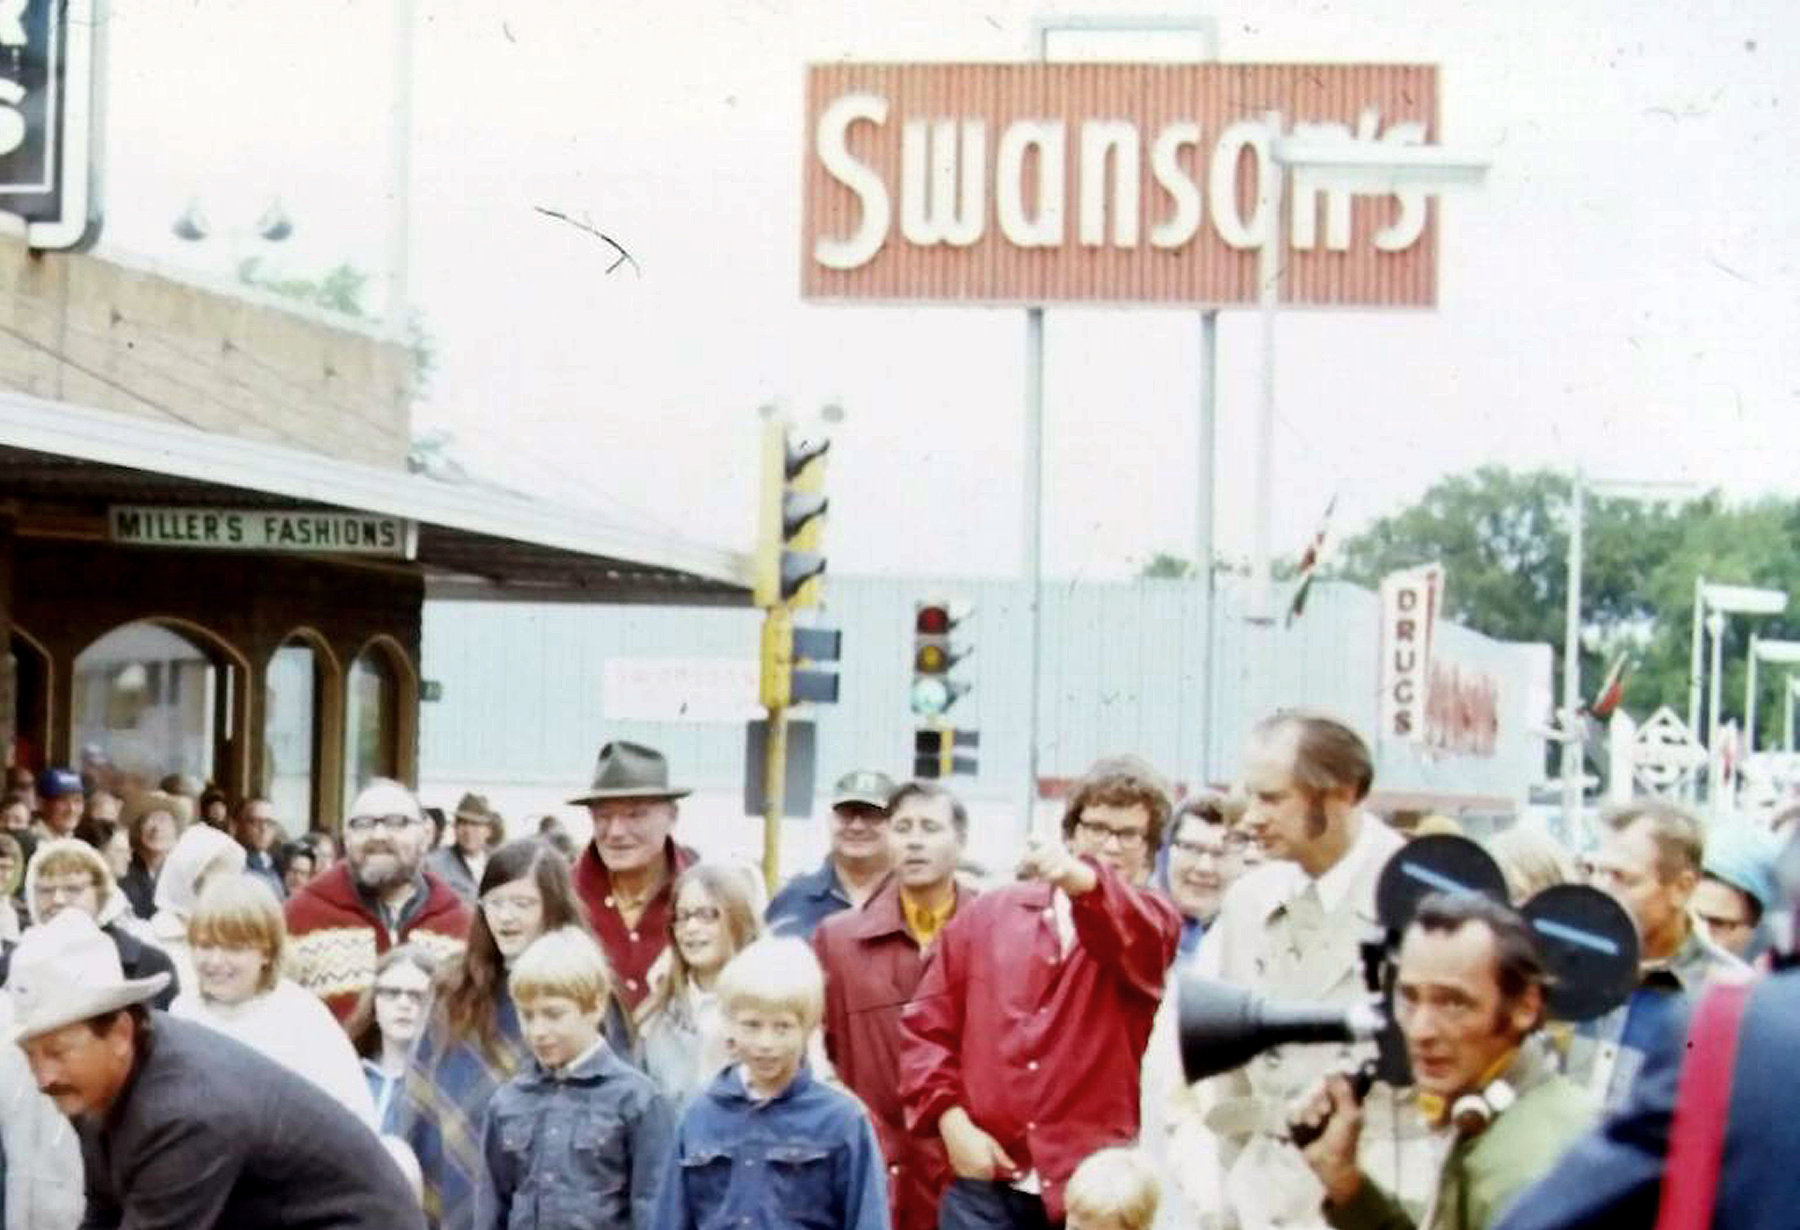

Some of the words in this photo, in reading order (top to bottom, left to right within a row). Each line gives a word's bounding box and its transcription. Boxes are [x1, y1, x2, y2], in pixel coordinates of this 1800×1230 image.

[814, 92, 1428, 270] Swanson's
[117, 511, 243, 542] MILLER'S
[264, 516, 395, 547] FASHIONS
